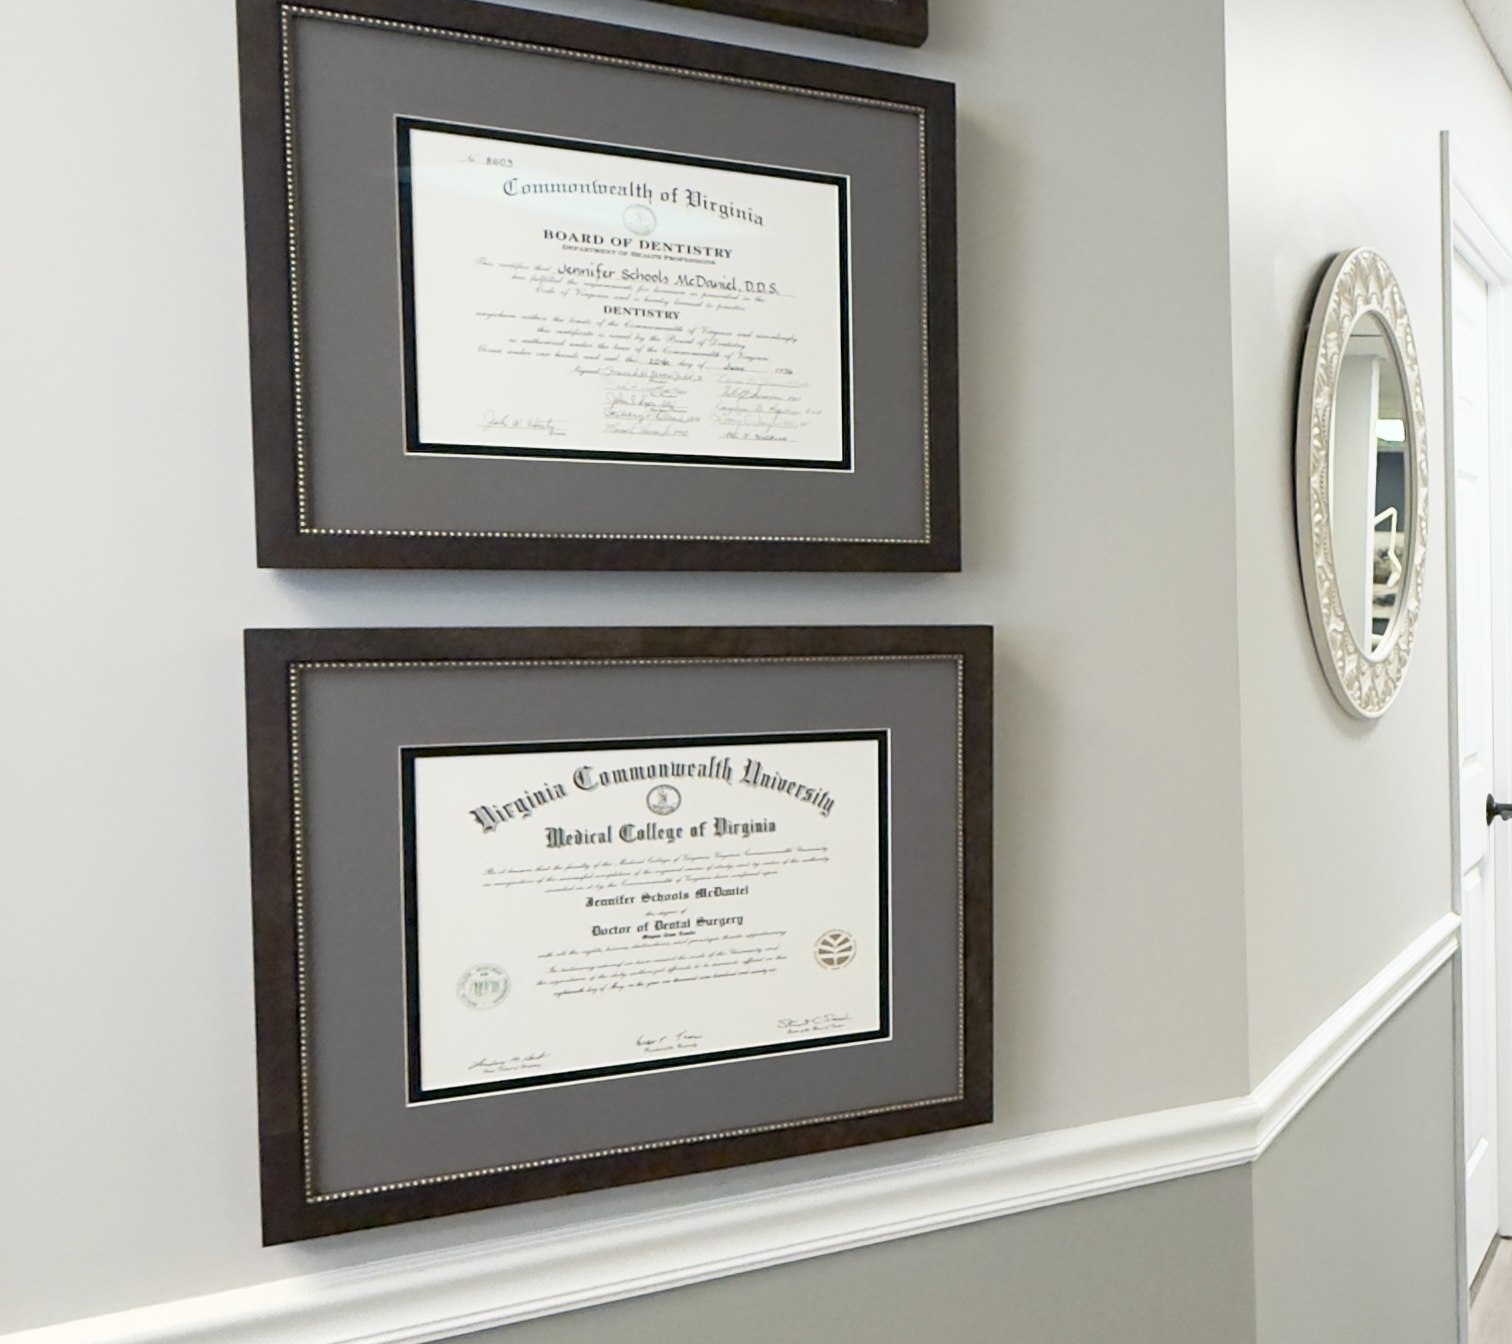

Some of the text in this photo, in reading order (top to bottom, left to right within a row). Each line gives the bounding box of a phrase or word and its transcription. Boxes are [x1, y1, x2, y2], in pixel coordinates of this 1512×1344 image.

[503, 177, 763, 226] Commonwealth of Virginia
[543, 229, 732, 259] BOARD OF DENTISTRY
[557, 262, 615, 283] Jennifer
[621, 267, 669, 285] Schools
[603, 305, 680, 320] DENTISTRY
[469, 755, 836, 834] Virginia Commonwealth University
[544, 817, 776, 849] Medical College of Virginia
[585, 885, 749, 907] Jennifer Schools McDaniel
[592, 915, 744, 937] Doctor of Dental Surgery
